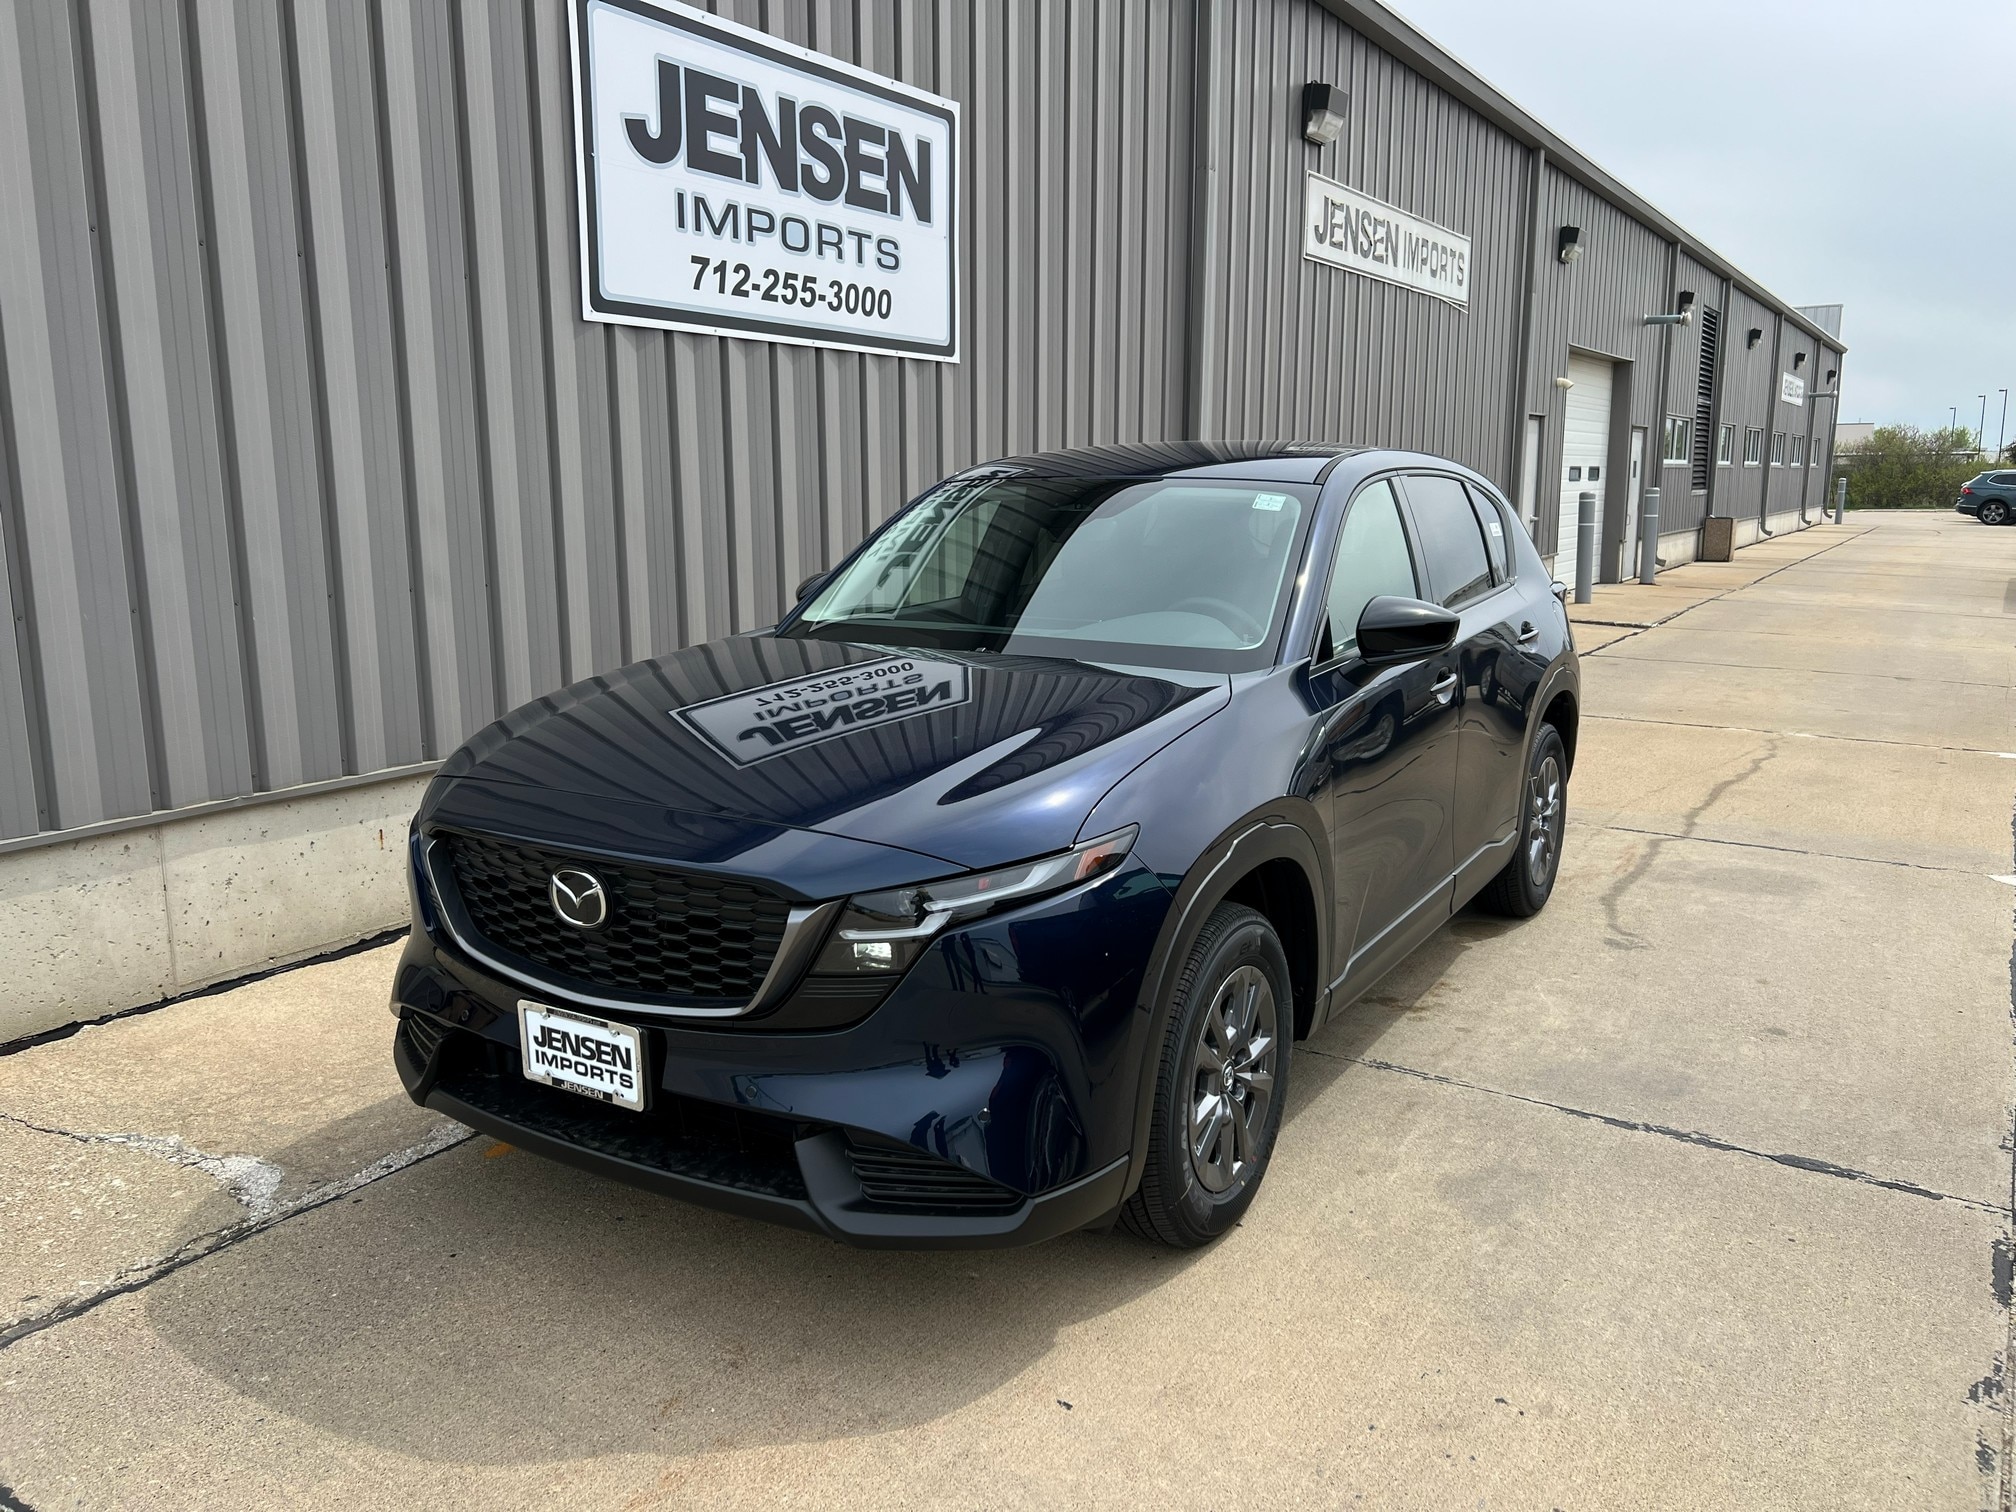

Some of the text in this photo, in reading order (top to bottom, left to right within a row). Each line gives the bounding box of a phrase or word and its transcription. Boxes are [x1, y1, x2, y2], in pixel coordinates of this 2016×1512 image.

[621, 54, 933, 227] JENSEN
[675, 189, 901, 272] IMPORTS
[1314, 195, 1465, 287] JENSEN IMPORTS
[690, 255, 892, 319] 712-255-3000
[533, 1025, 632, 1071] JENSEN
[535, 1050, 633, 1089] IMPORTS
[561, 1080, 604, 1099] JENSEN
